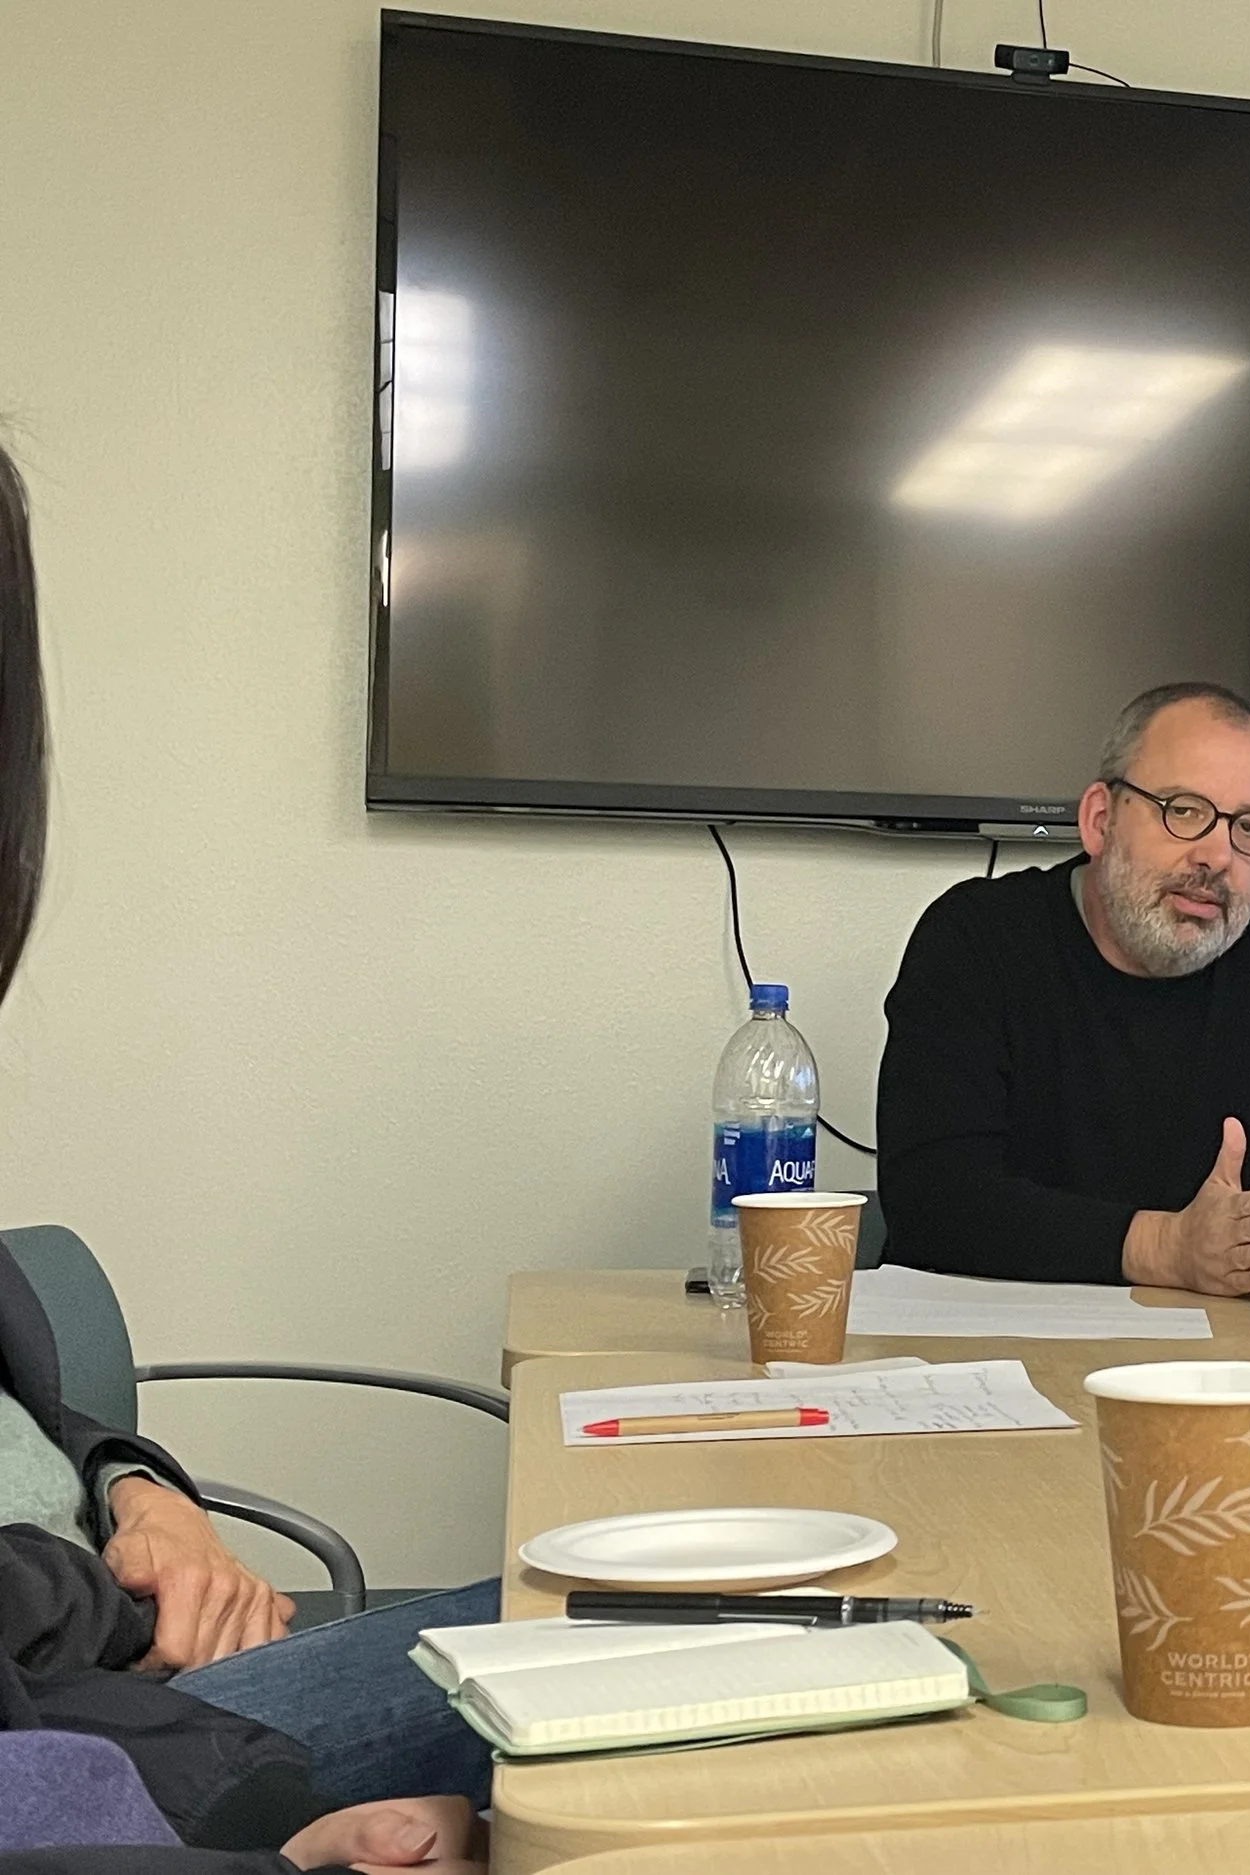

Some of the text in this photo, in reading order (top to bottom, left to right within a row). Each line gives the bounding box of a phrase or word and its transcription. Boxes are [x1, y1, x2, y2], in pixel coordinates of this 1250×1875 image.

[1020, 805, 1066, 814] SHARP
[764, 1330, 808, 1339] WORLD
[763, 1339, 809, 1348] CENTRIC
[1167, 1651, 1250, 1670] WORLD
